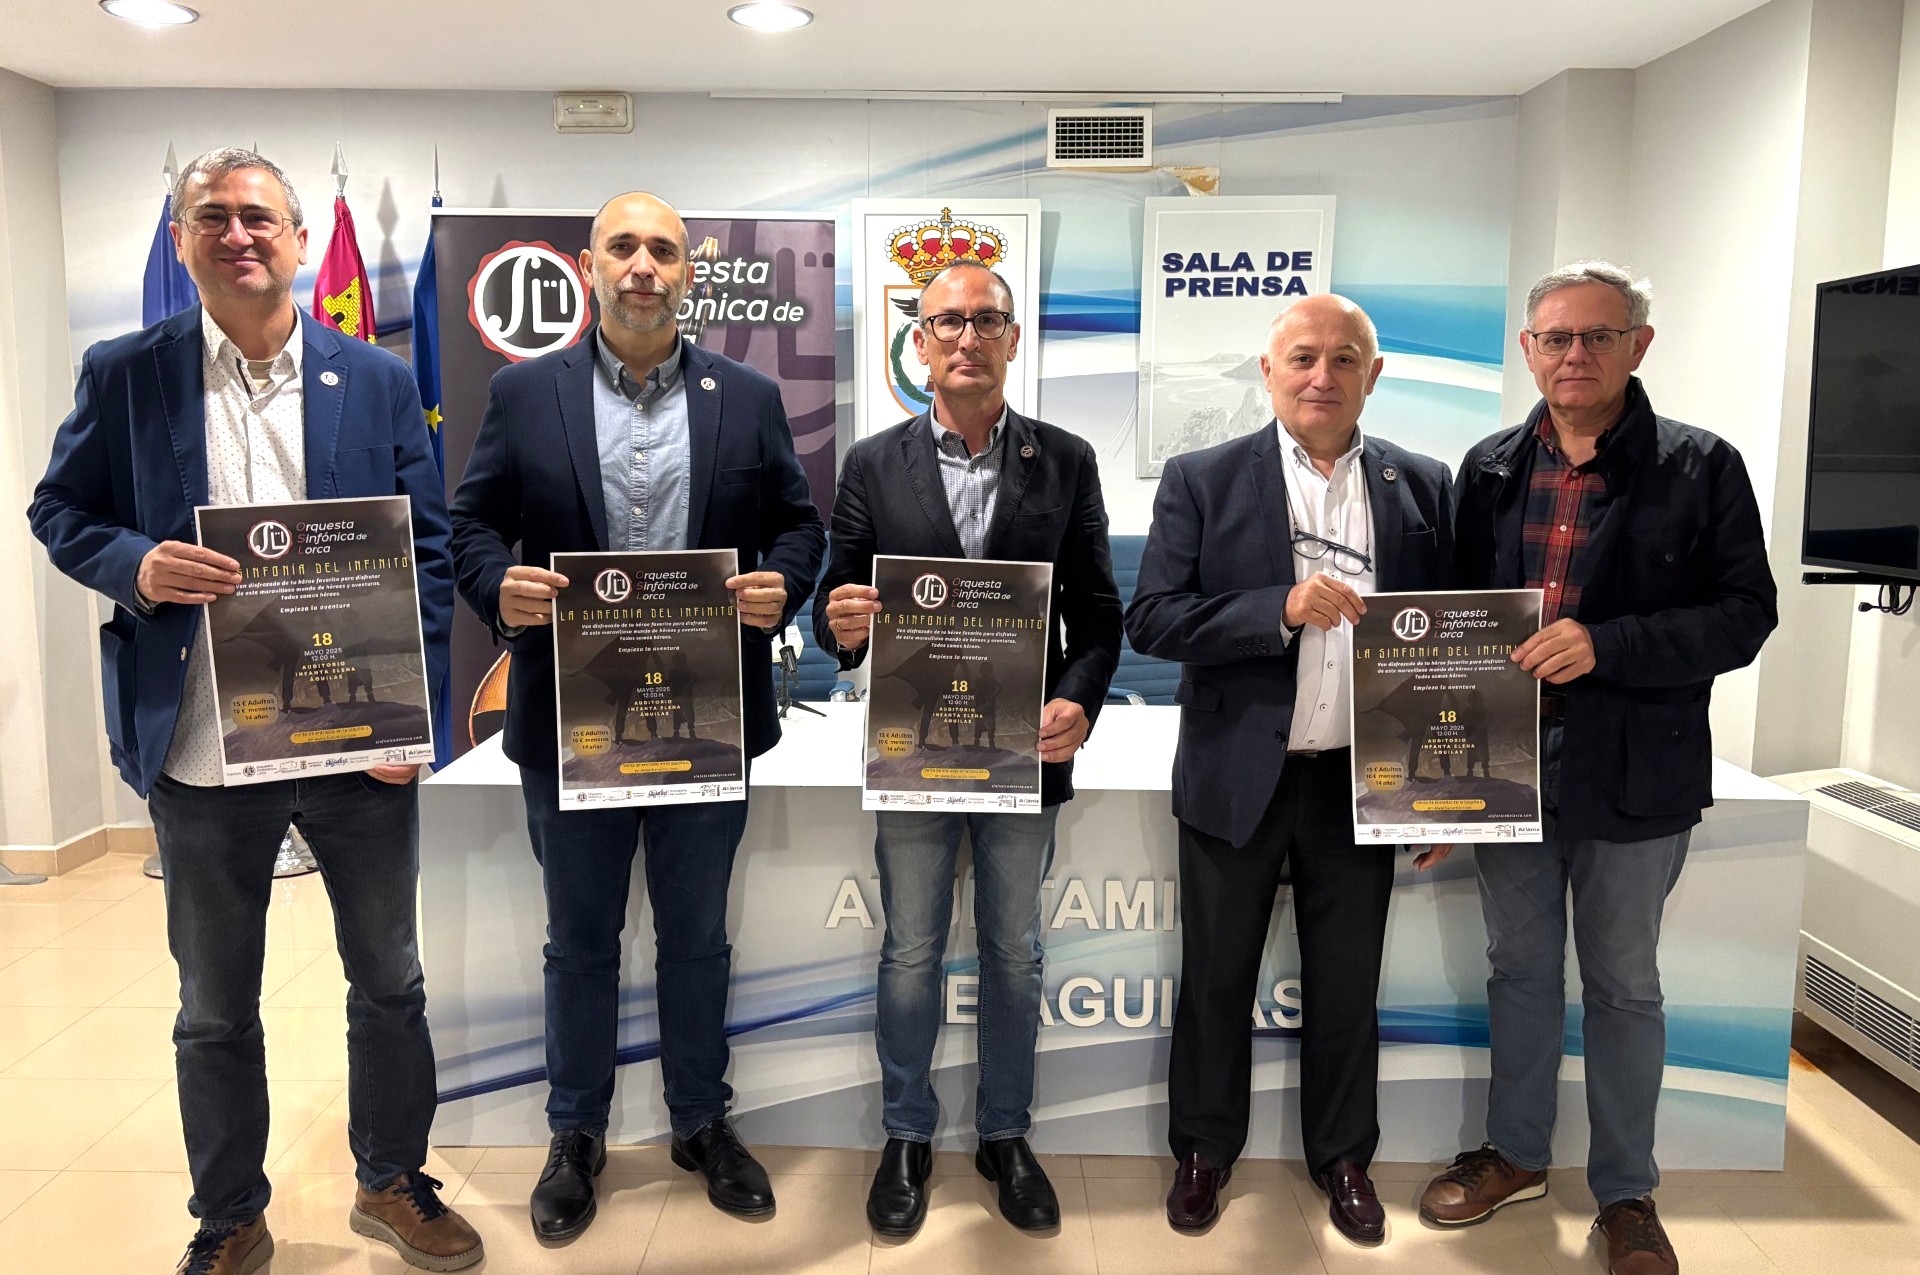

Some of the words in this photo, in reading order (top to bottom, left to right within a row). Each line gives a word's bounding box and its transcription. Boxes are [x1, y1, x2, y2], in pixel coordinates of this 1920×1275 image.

[1162, 252, 1254, 273] SALA
[1266, 251, 1313, 272] DE
[1165, 276, 1308, 298] PRENSA
[773, 302, 804, 322] de
[296, 520, 354, 532] Orquesta
[297, 532, 354, 544] Sinfónica
[298, 545, 330, 555] Lorca
[316, 562, 340, 573] DEL
[348, 557, 408, 571] INFINITO
[636, 570, 688, 581] Orquesta
[636, 580, 686, 592] Sinfónica
[952, 578, 1002, 590] Orquesta
[636, 592, 666, 600] Lorca
[952, 588, 1000, 600] Sinfónica
[280, 606, 308, 614] Empieza
[952, 600, 978, 608] Lorca
[560, 610, 574, 622] LA
[583, 607, 642, 620] SINFONÍA
[651, 608, 672, 618] DEL
[680, 606, 733, 618] INFINITO
[1434, 609, 1488, 620] Orquesta
[876, 613, 890, 624] LA
[898, 614, 954, 626] SINFONÍA
[964, 616, 984, 628] DEL
[992, 618, 1043, 630] INFINITO
[1434, 619, 1486, 630] Sinfónica
[312, 632, 333, 646] 18
[1434, 630, 1464, 638] Lorca
[1357, 648, 1370, 659] LA
[1379, 646, 1438, 658] SINFONÍA
[1448, 646, 1469, 657] DEL
[302, 661, 346, 670] AUDITORIO
[644, 672, 662, 685] 18
[952, 680, 968, 692] 18
[248, 698, 275, 706] Adultos
[1438, 710, 1456, 723] 18
